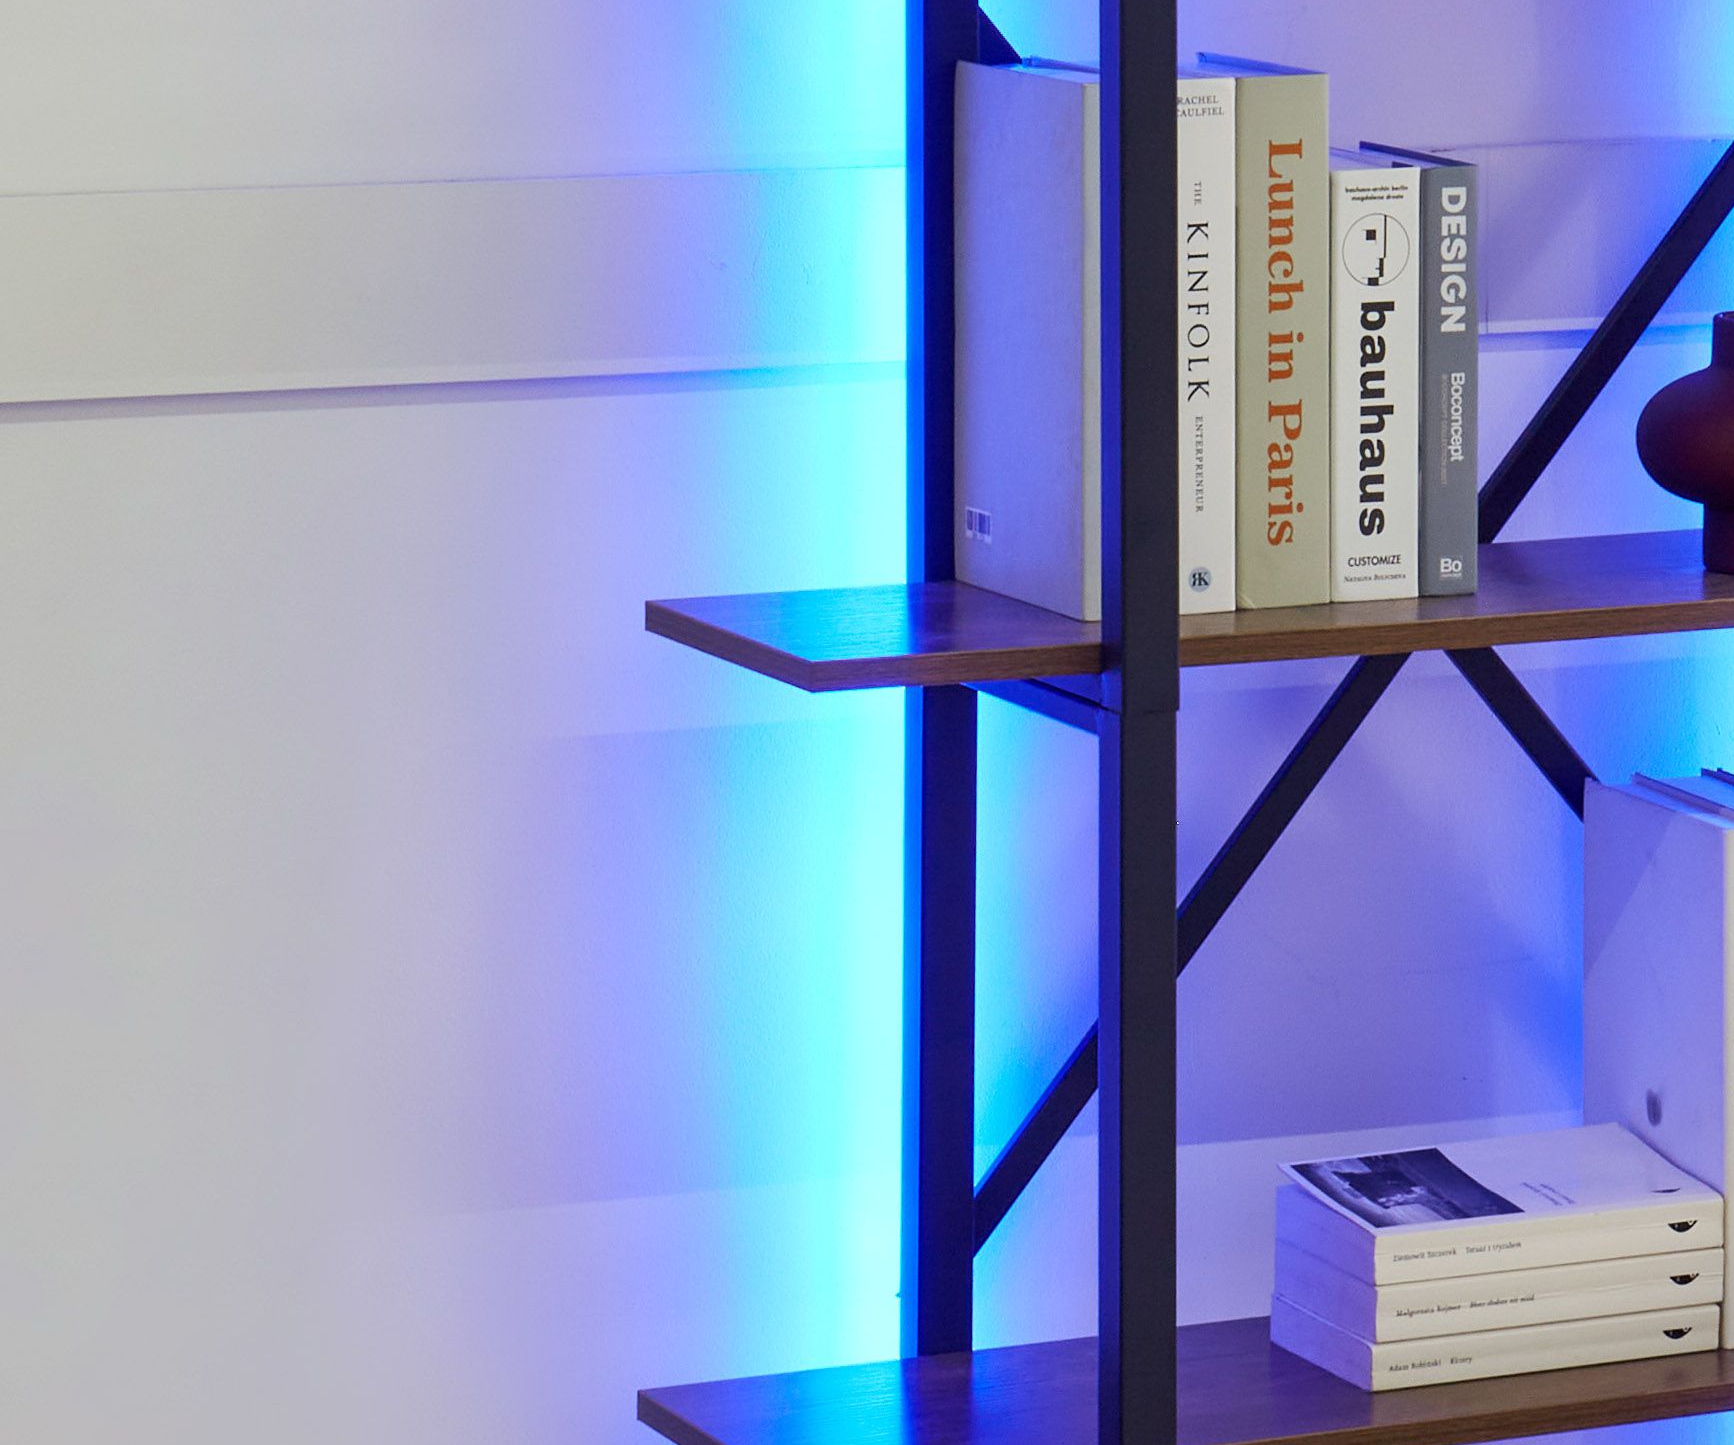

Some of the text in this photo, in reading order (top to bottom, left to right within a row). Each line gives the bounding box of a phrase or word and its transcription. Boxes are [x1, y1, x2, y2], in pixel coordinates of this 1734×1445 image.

[1441, 187, 1467, 332] DESIGN
[1187, 181, 1209, 513] THE KINFOLK ENTERPRENEUR
[1267, 139, 1304, 546] Lunch in Paris
[1359, 301, 1394, 536] bauhaus
[1448, 373, 1465, 461] Boconcept
[1347, 555, 1402, 568] CUSTOMIZE
[1440, 558, 1462, 573] Bo
